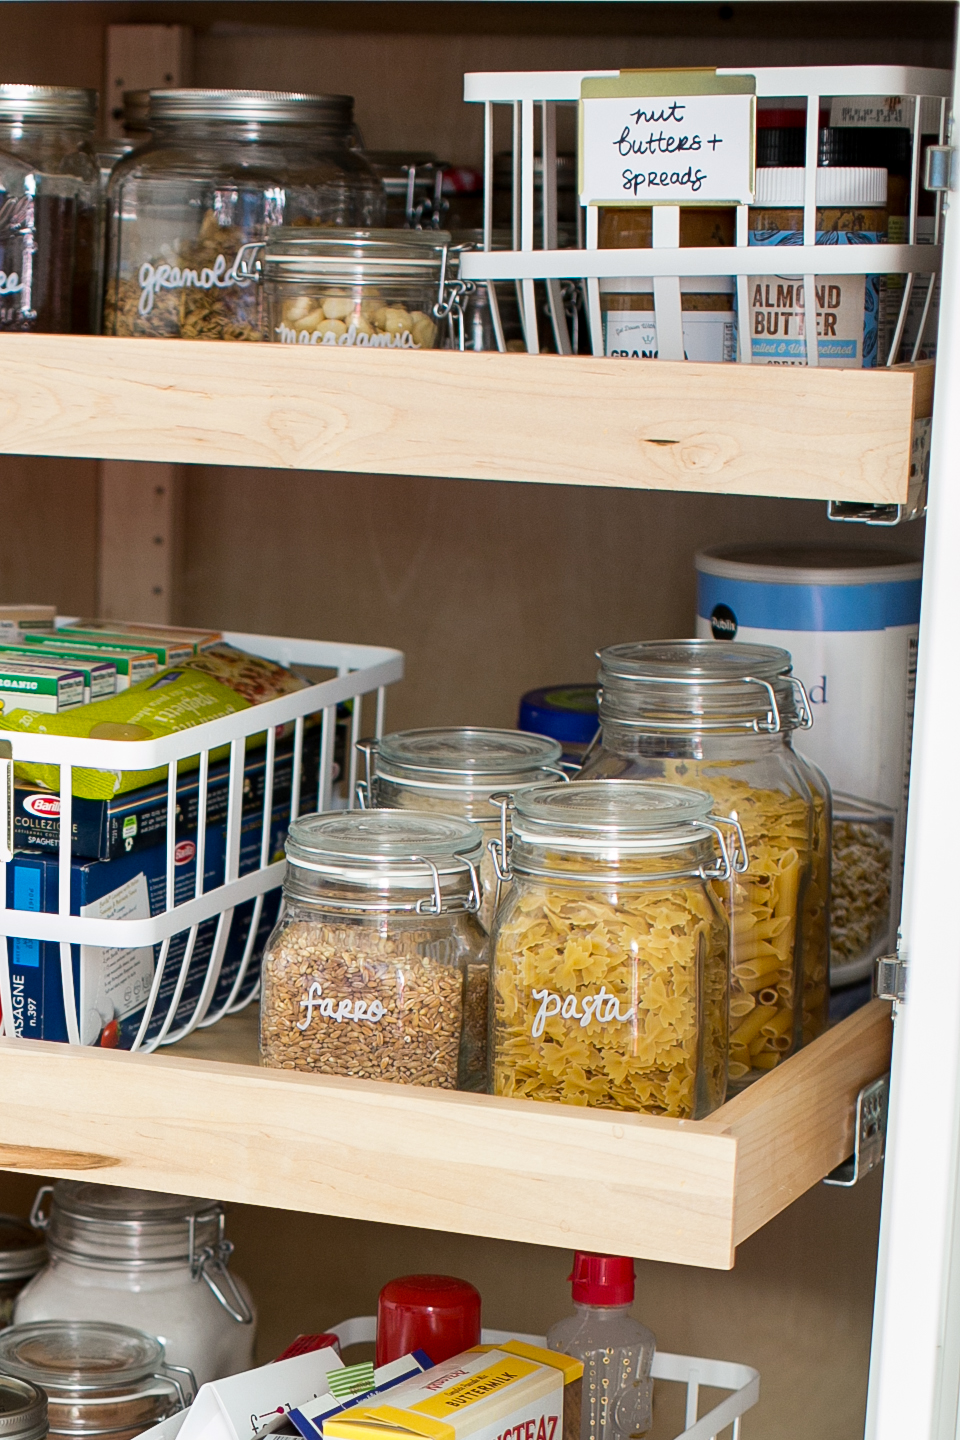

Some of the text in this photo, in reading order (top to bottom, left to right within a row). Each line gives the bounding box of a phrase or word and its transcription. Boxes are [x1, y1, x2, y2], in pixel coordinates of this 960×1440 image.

[630, 101, 686, 125] nut
[622, 166, 707, 196] spreads
[12, 974, 25, 1039] ASAGNE
[27, 997, 37, 1028] n.397
[296, 982, 387, 1031] farro
[531, 986, 635, 1038] pasta
[445, 1371, 518, 1408] BUTTERMILK
